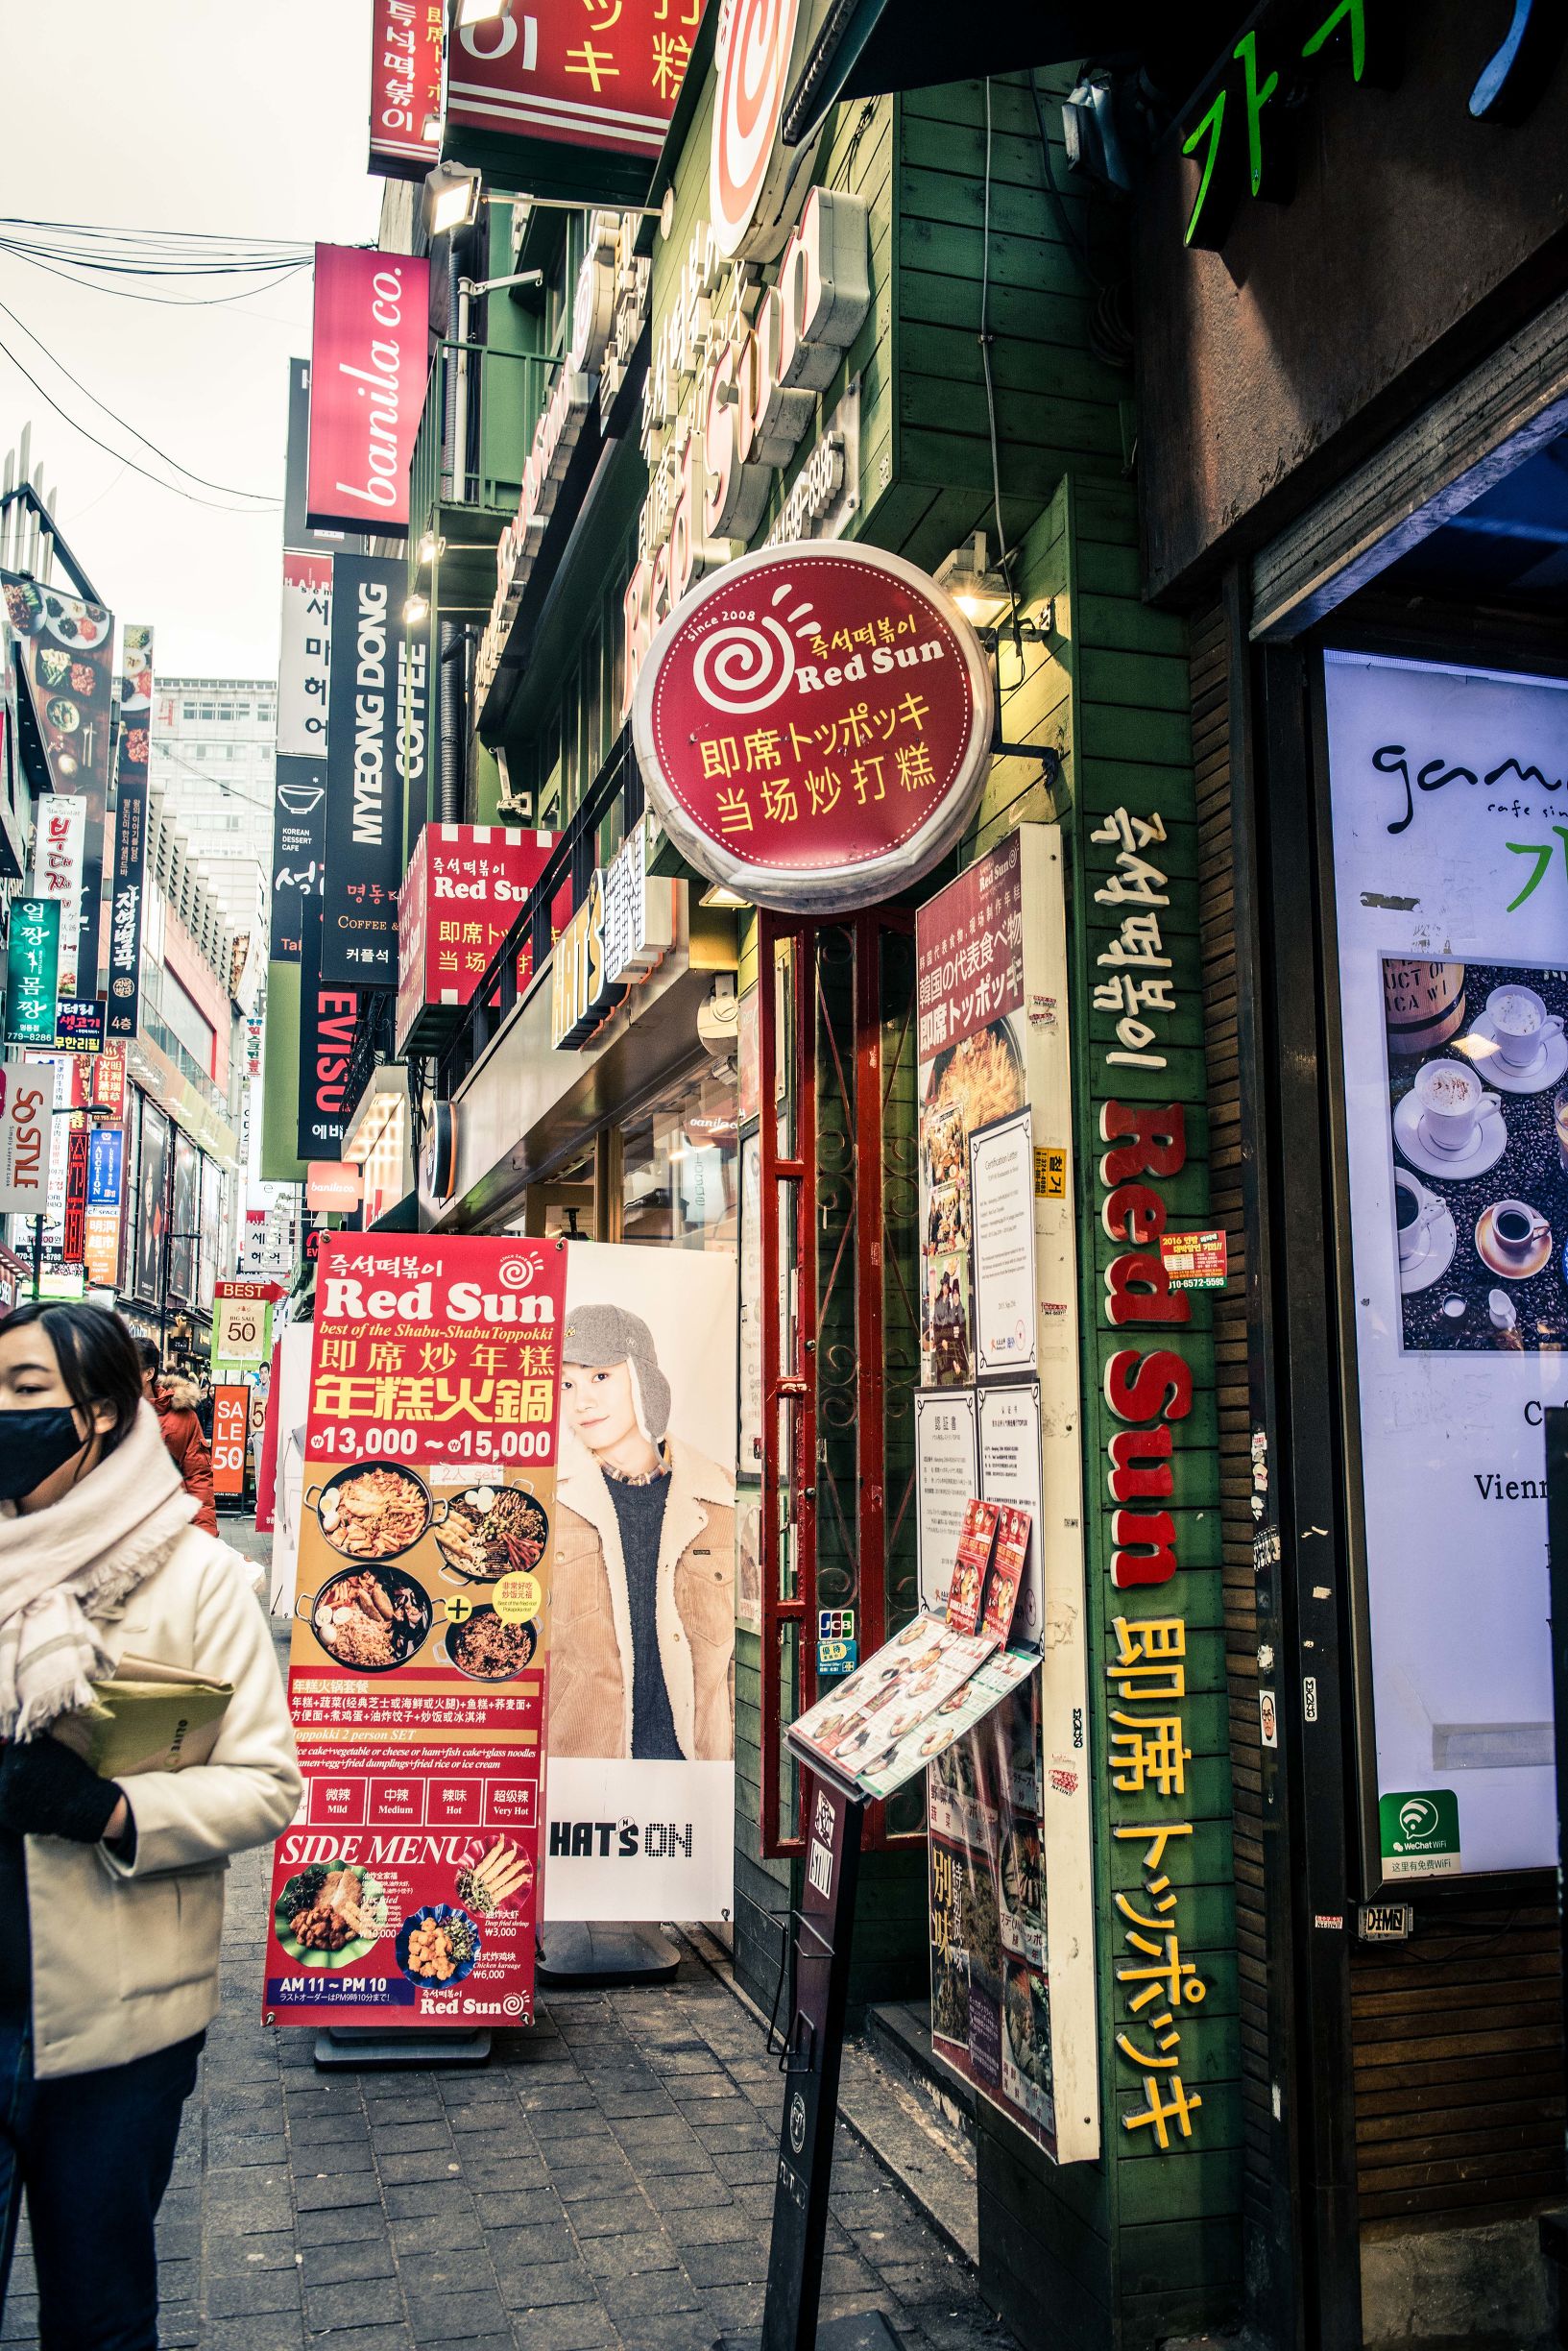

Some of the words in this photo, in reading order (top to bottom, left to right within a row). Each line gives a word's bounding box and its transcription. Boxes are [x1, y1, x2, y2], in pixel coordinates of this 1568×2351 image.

[336, 336, 400, 507] banila
[372, 267, 402, 327] co.
[356, 583, 388, 689] DONG
[687, 617, 719, 642] since
[721, 609, 756, 622] 2008
[810, 614, 917, 660] 즉석떡볶이
[795, 656, 867, 694] Red
[872, 639, 945, 675] Sun
[395, 641, 425, 779] COFFEE
[699, 691, 930, 781] 即席トッポッキ
[352, 694, 385, 845] MYEONG
[716, 741, 936, 835] 当场炒打糕
[1488, 801, 1531, 817] cafe
[282, 828, 310, 836] KOREAN
[282, 836, 312, 845] DESSERT
[433, 857, 505, 877] 즉석떡볶이
[978, 869, 994, 892] Red
[994, 859, 1009, 881] Sun
[434, 876, 487, 900] Red
[494, 879, 534, 903] Su
[20, 903, 50, 946] 얼짱
[113, 884, 140, 971] 자연별곡
[337, 915, 387, 931] COFFEE
[1091, 807, 1176, 1070] 즉석떡볶이
[346, 948, 389, 963] 커플석
[919, 909, 1023, 1010] 韓国の代表食べ物
[16, 976, 47, 1019] 몸짱
[919, 957, 1024, 1054] 即席トッポッキ
[60, 1016, 101, 1030] 생고기
[111, 1016, 132, 1030] 4층
[7, 1032, 52, 1042] 779-8286
[55, 1036, 100, 1052] 무한리필
[315, 991, 357, 1113] EVISU
[12, 1087, 44, 1124] SO
[13, 1126, 41, 1189] STYLE
[93, 1146, 103, 1196] AUCTION
[1099, 1100, 1193, 1325] Red
[1163, 1237, 1182, 1246] 2016
[329, 1253, 443, 1280] 즉석떡볶이
[223, 1284, 265, 1297] BEST
[323, 1278, 433, 1321] Red
[446, 1281, 556, 1324] Sun
[227, 1322, 256, 1342] 50
[320, 1321, 350, 1336] best
[351, 1322, 369, 1339] of
[370, 1323, 393, 1336] the
[319, 1339, 556, 1376] 即席炒年糕
[217, 1400, 244, 1419] SA
[313, 1374, 554, 1423] 年糕火鍋
[252, 1401, 267, 1429] 5
[217, 1422, 243, 1441] LE
[212, 1446, 244, 1470] 50
[1104, 1349, 1193, 1589] Sun
[821, 1620, 852, 1631] JCB
[293, 1679, 370, 1694] 年糕火锅套餐
[341, 1729, 350, 1740] 2
[351, 1732, 388, 1743] person
[390, 1730, 417, 1741] SET
[297, 1758, 365, 1770] amen+egg+fried
[435, 1759, 450, 1769] rice
[451, 1760, 461, 1769] or
[462, 1759, 474, 1769] ice
[475, 1760, 501, 1770] cream
[308, 1747, 371, 1757] cake+vegetable
[372, 1748, 381, 1757] or
[382, 1747, 410, 1757] cheese
[411, 1748, 421, 1757] or
[422, 1748, 461, 1758] ham+fish
[462, 1748, 506, 1759] cake+glass
[507, 1749, 536, 1758] noodles
[325, 1788, 351, 1803] 微辣
[384, 1788, 409, 1803] 中辣
[442, 1789, 468, 1803] 辣味
[494, 1790, 529, 1804] 超级辣
[327, 1805, 348, 1814] Mild
[378, 1805, 414, 1815] Medium
[446, 1806, 462, 1815] Hot
[494, 1806, 512, 1816] Very
[514, 1806, 529, 1815] Hot
[279, 1834, 360, 1864] SIDE
[365, 1834, 474, 1865] MENU
[644, 1823, 692, 1857] ON
[1404, 1841, 1433, 1851] WeChat
[1432, 1839, 1447, 1849] WiFi
[1392, 1857, 1451, 1873] 这里有免费WiFi
[1106, 1615, 1206, 2149] 即席トッポッキ
[485, 1909, 519, 1920] 油炸大虾
[485, 1927, 517, 1938] ₩3,000
[279, 1977, 304, 1992] AM
[308, 1977, 325, 1992] 11
[342, 1977, 366, 1992] PM
[370, 1977, 387, 1992] 10
[472, 1969, 505, 1980] ₩6,000
[421, 1999, 459, 2014] Red
[463, 1998, 501, 2014] Sun
